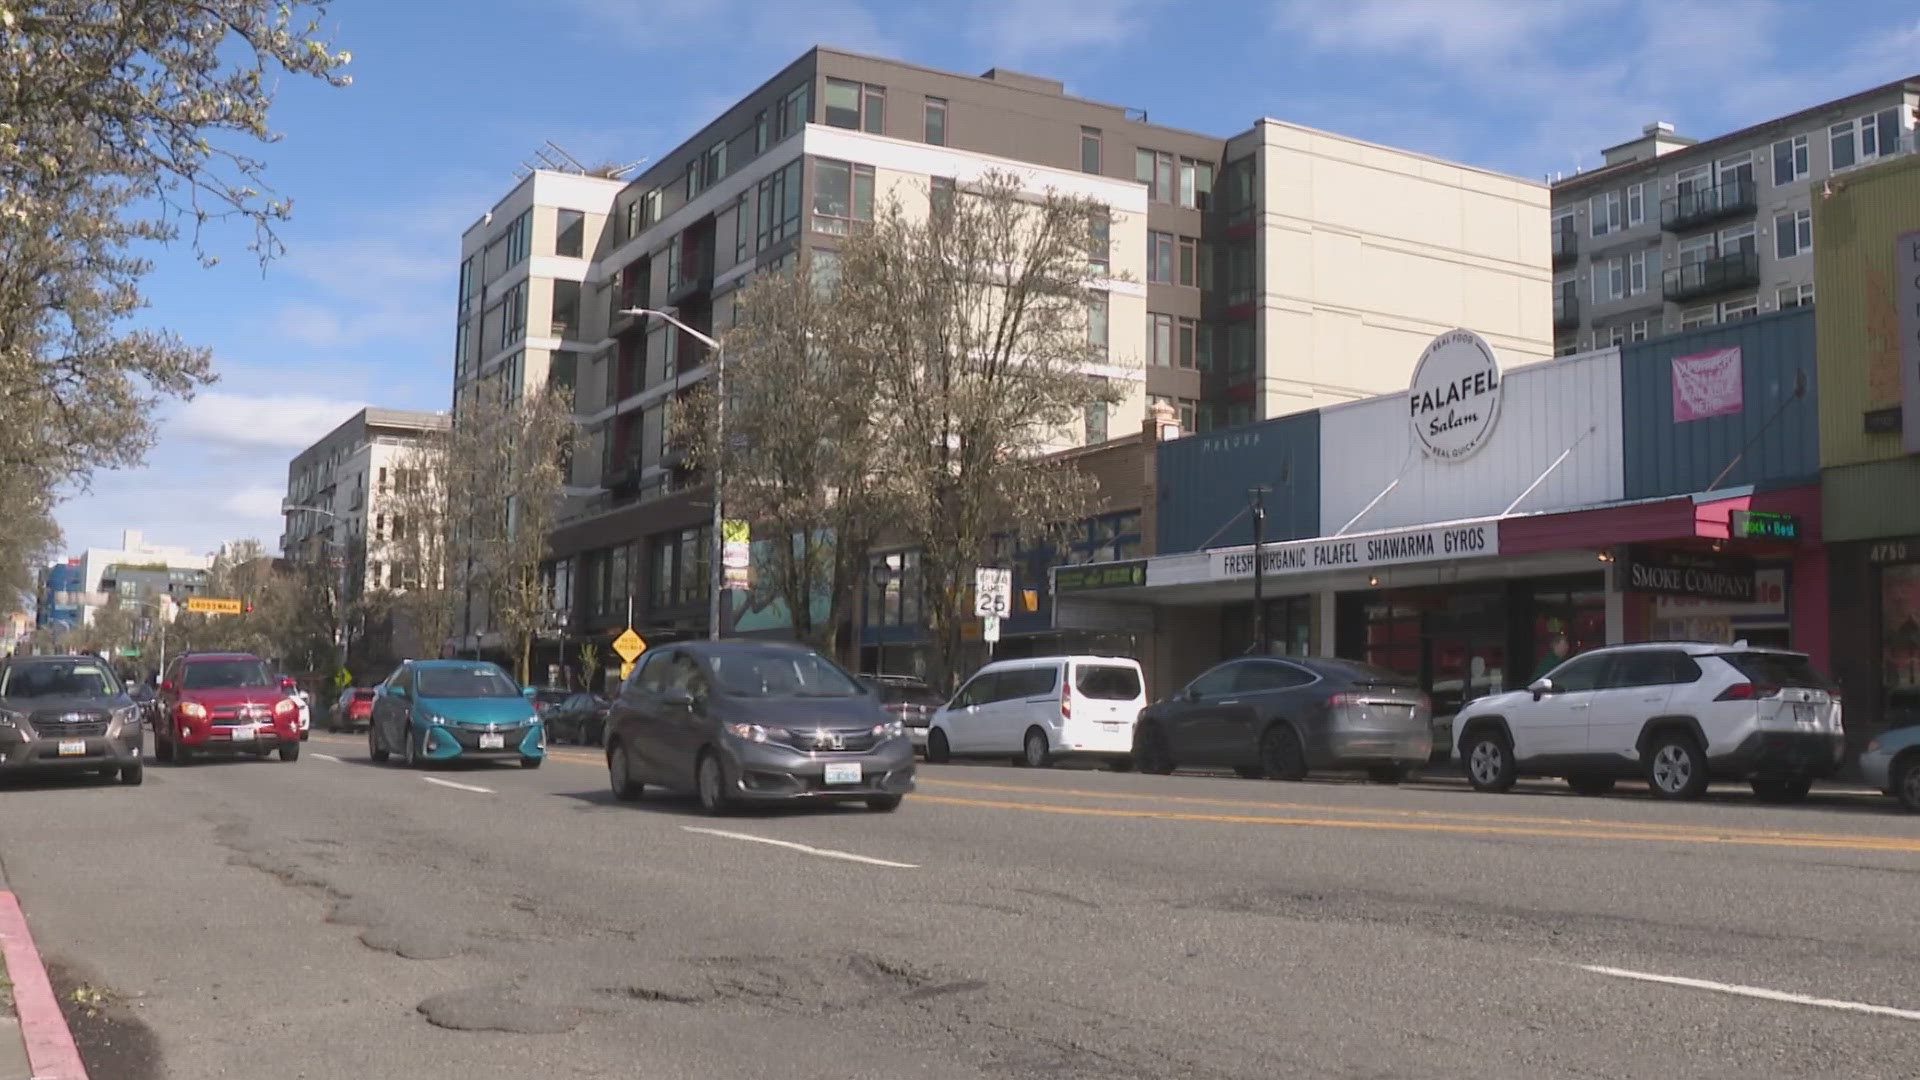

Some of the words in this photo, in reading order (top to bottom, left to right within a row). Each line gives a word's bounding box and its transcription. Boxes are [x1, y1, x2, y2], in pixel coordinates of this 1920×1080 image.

[1432, 337, 1450, 352] REAL
[1410, 368, 1498, 418] FALAFEL
[1429, 408, 1478, 437] Salam
[1432, 446, 1450, 459] REAL
[1451, 441, 1476, 458] QUICK
[1224, 554, 1254, 575] FRESH
[1261, 547, 1306, 571] ORGANIC
[1314, 542, 1358, 565] FALAFEL
[1367, 534, 1435, 561] SHAWARMA
[1444, 527, 1485, 552] GYROS
[1685, 567, 1751, 597] COMPANY
[980, 593, 1005, 611] 25
